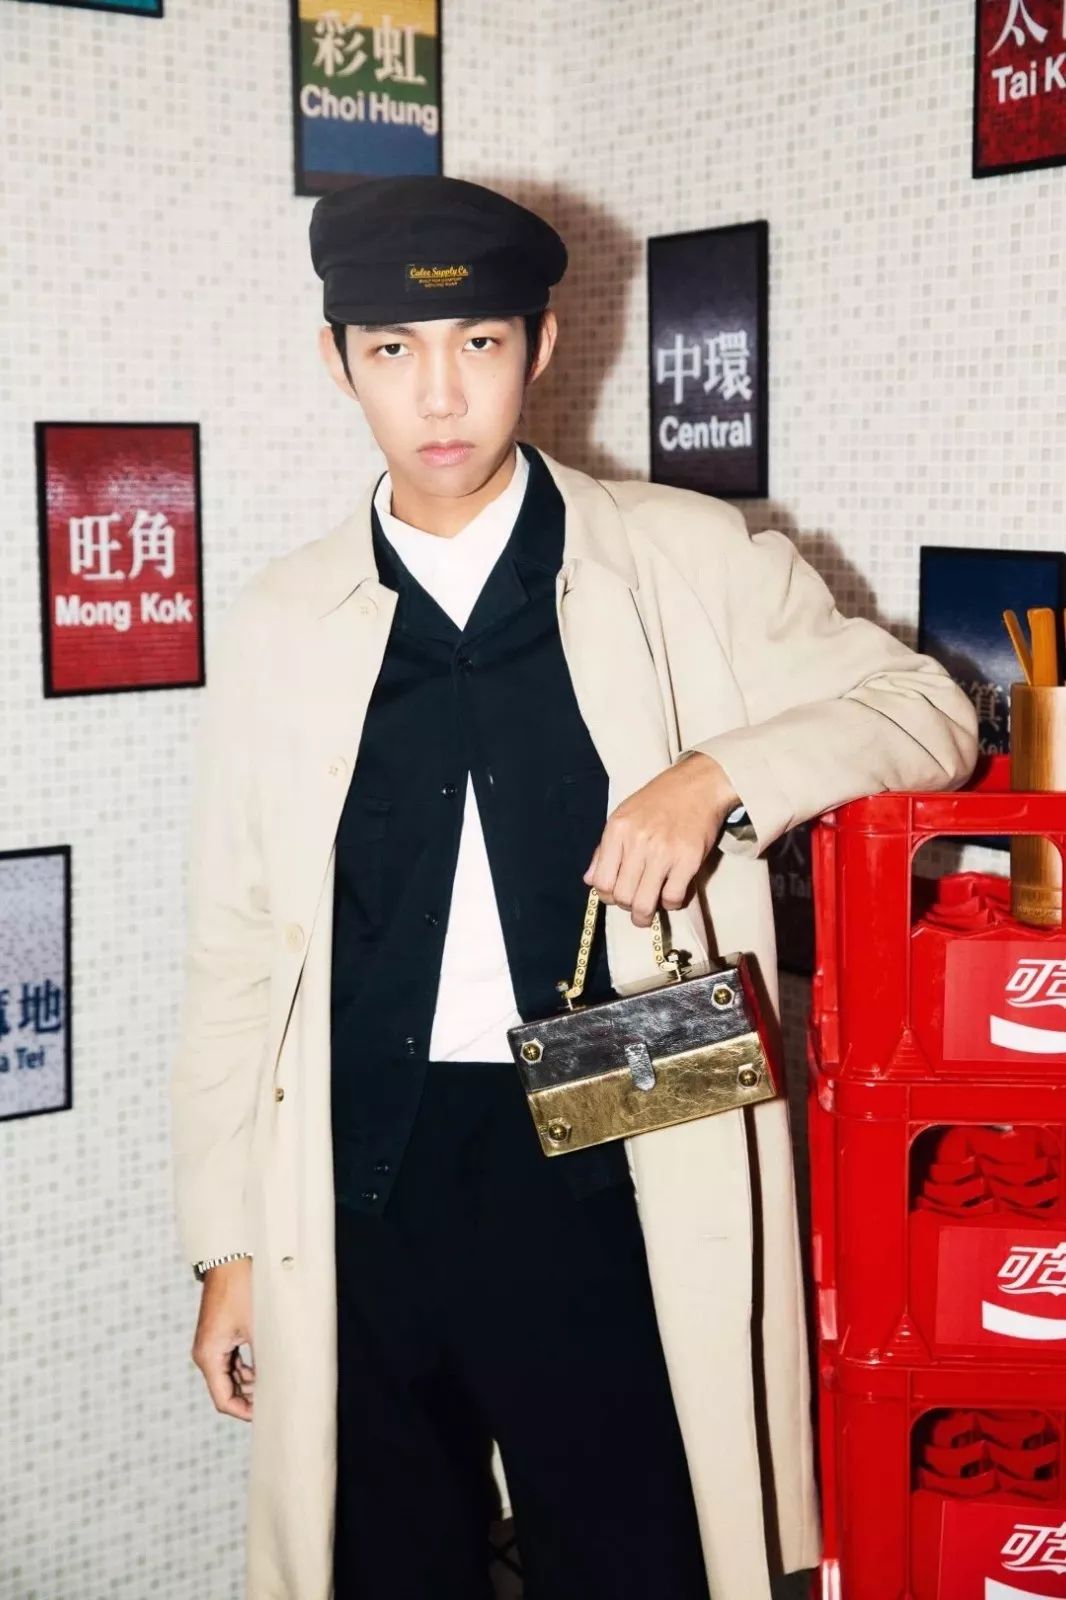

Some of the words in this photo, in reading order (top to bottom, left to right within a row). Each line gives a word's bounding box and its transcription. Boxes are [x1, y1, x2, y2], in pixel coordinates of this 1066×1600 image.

[312, 10, 427, 85] 彩虹
[991, 61, 1037, 104] Tai
[300, 84, 365, 121] Choi
[369, 91, 439, 135] Hung
[432, 266, 458, 278] Supply
[657, 329, 753, 404] 中環
[659, 412, 752, 451] Central
[69, 509, 175, 580] 旺角
[55, 594, 132, 632] Mong
[140, 592, 193, 624] Kok
